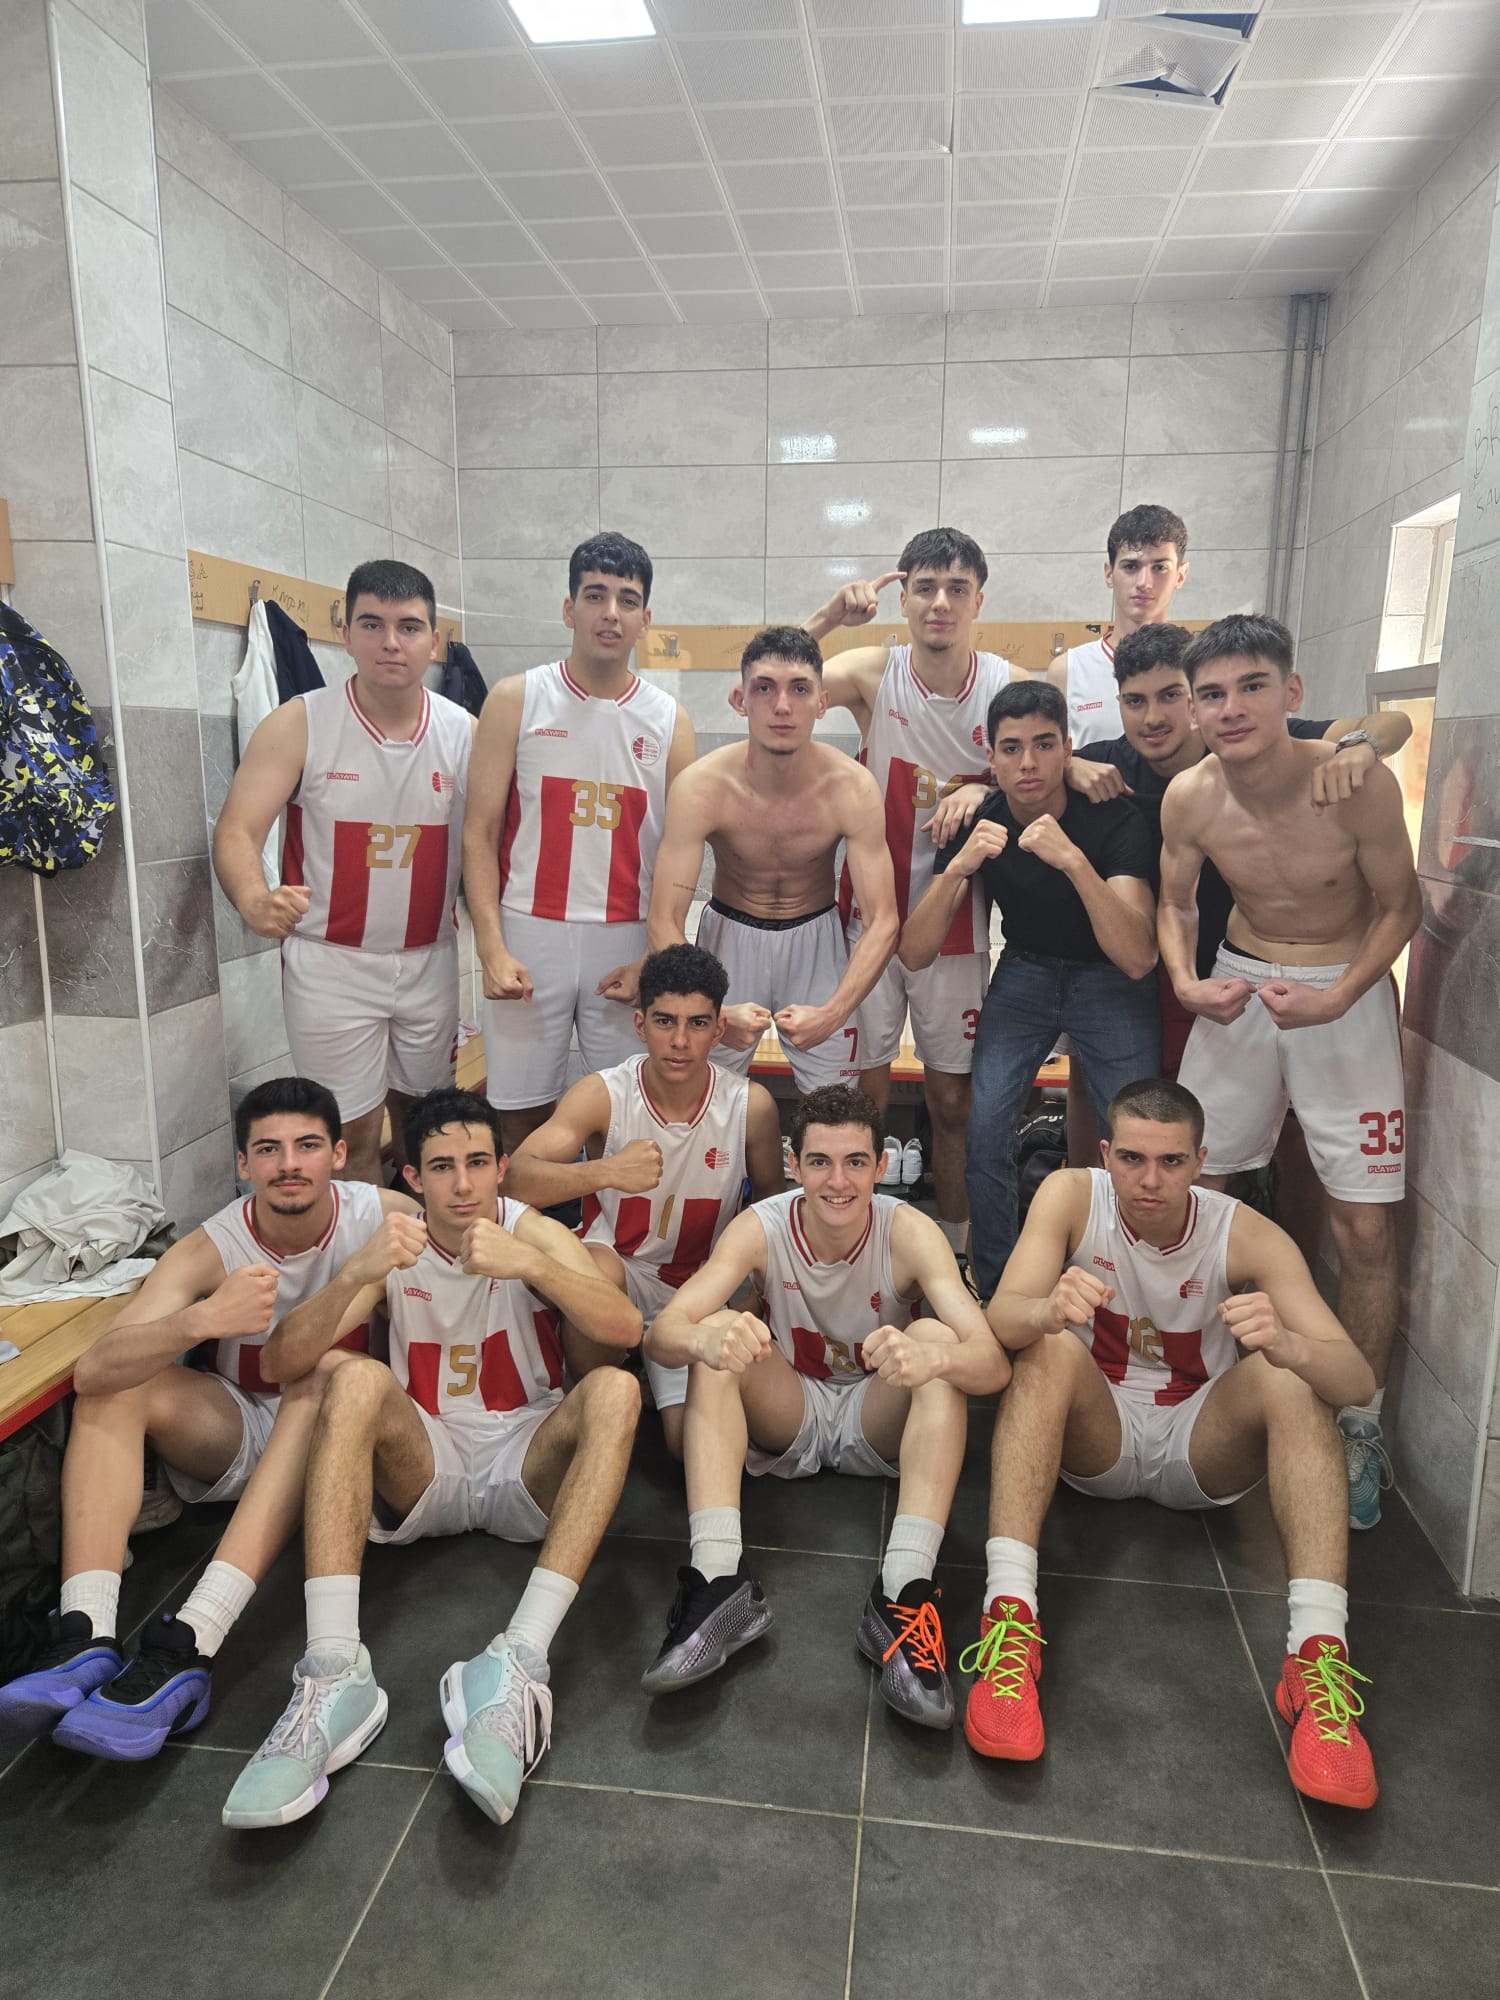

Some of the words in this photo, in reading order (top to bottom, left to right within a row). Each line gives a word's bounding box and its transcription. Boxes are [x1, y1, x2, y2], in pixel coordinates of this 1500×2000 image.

[568, 780, 624, 830] 35
[366, 824, 422, 868] 27
[843, 1027, 858, 1062] 7
[1359, 1109, 1404, 1155] 33
[657, 1194, 675, 1240] 1
[446, 1344, 478, 1397] 5
